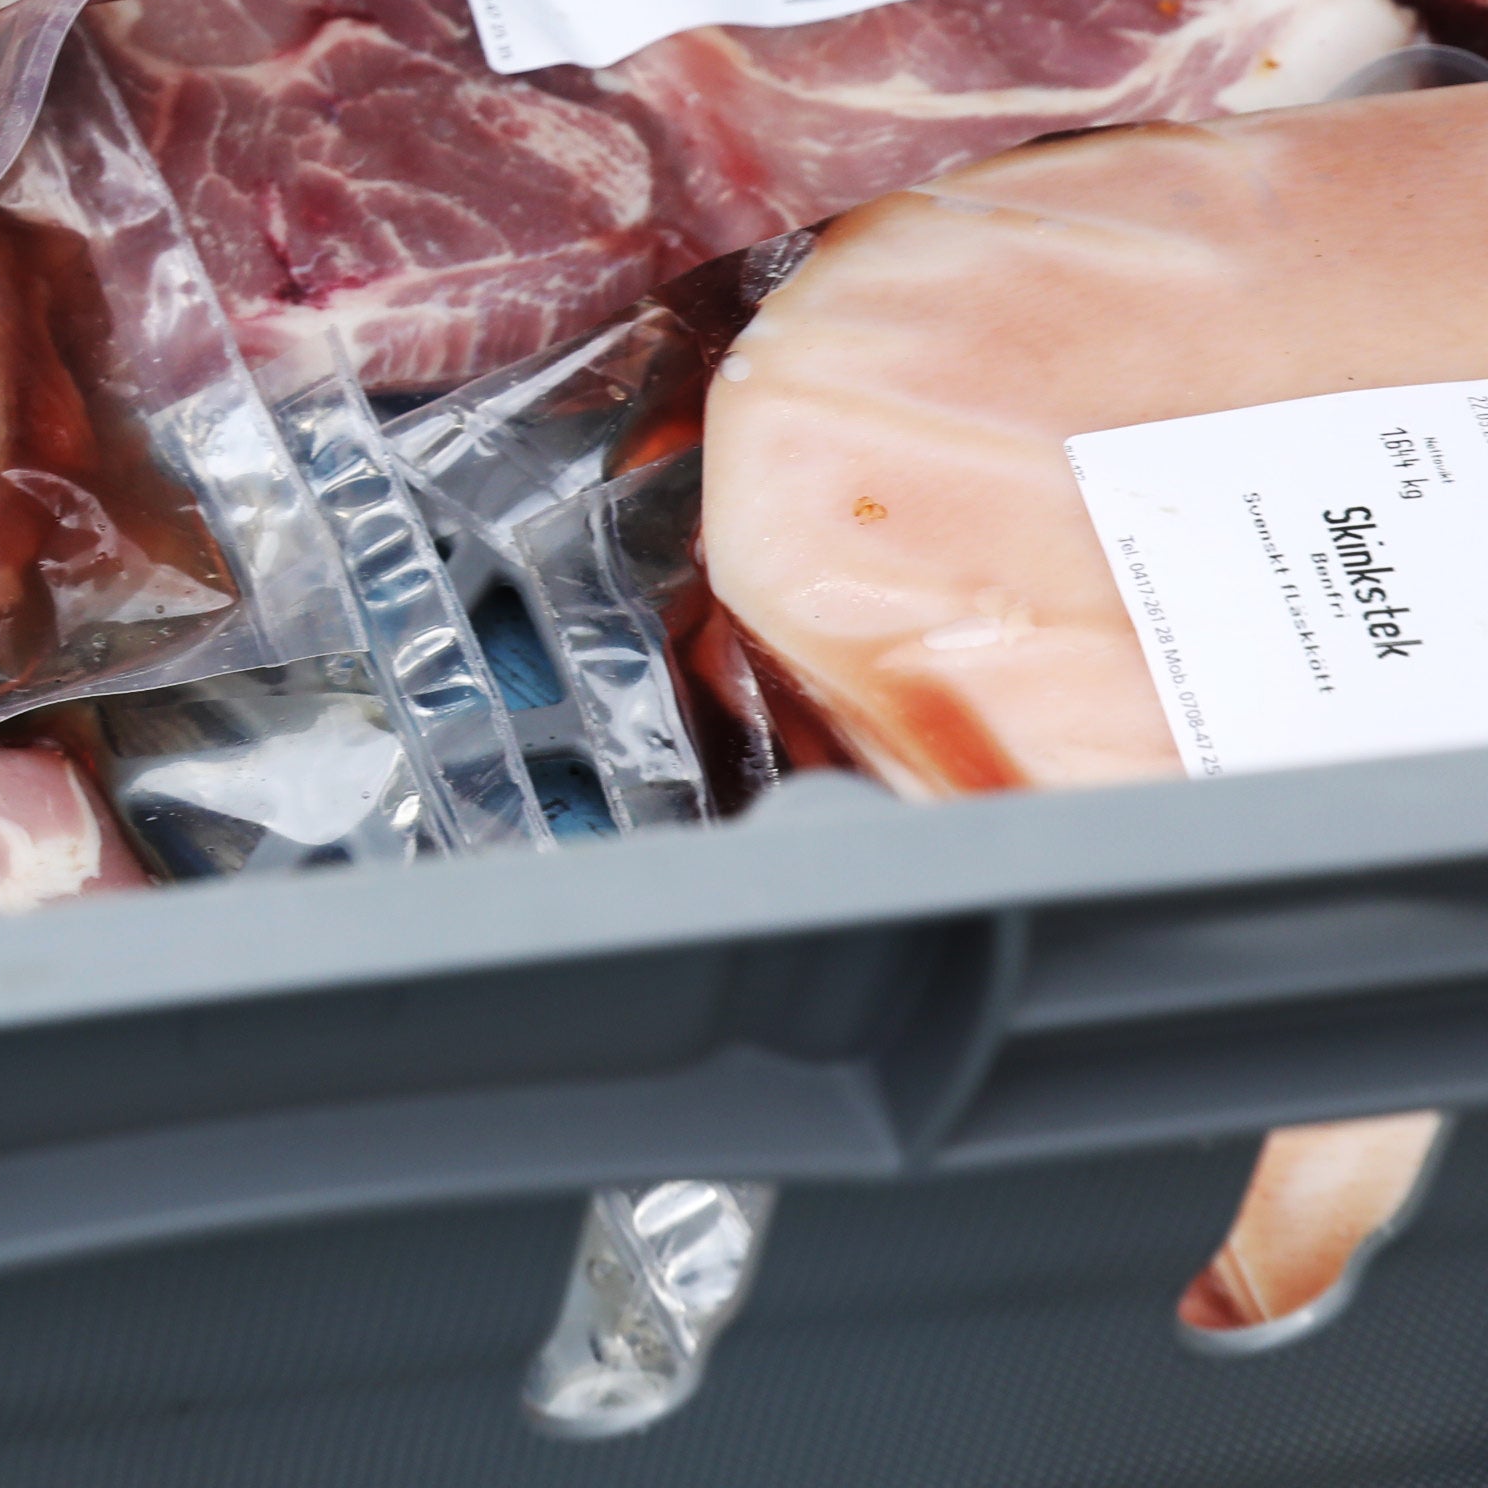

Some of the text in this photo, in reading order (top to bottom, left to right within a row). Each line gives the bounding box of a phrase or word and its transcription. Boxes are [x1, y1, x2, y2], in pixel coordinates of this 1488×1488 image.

[1378, 427, 1431, 501] 1,644 kg
[1118, 534, 1137, 560] Tel.
[1242, 491, 1291, 575] Svenskt
[1128, 561, 1165, 623] 0417-261
[1310, 551, 1351, 619] Benfri
[1322, 505, 1424, 660] Skinkstek
[1155, 624, 1175, 645] 28
[1164, 648, 1189, 689] Mob.
[1178, 690, 1214, 751] 0708-47
